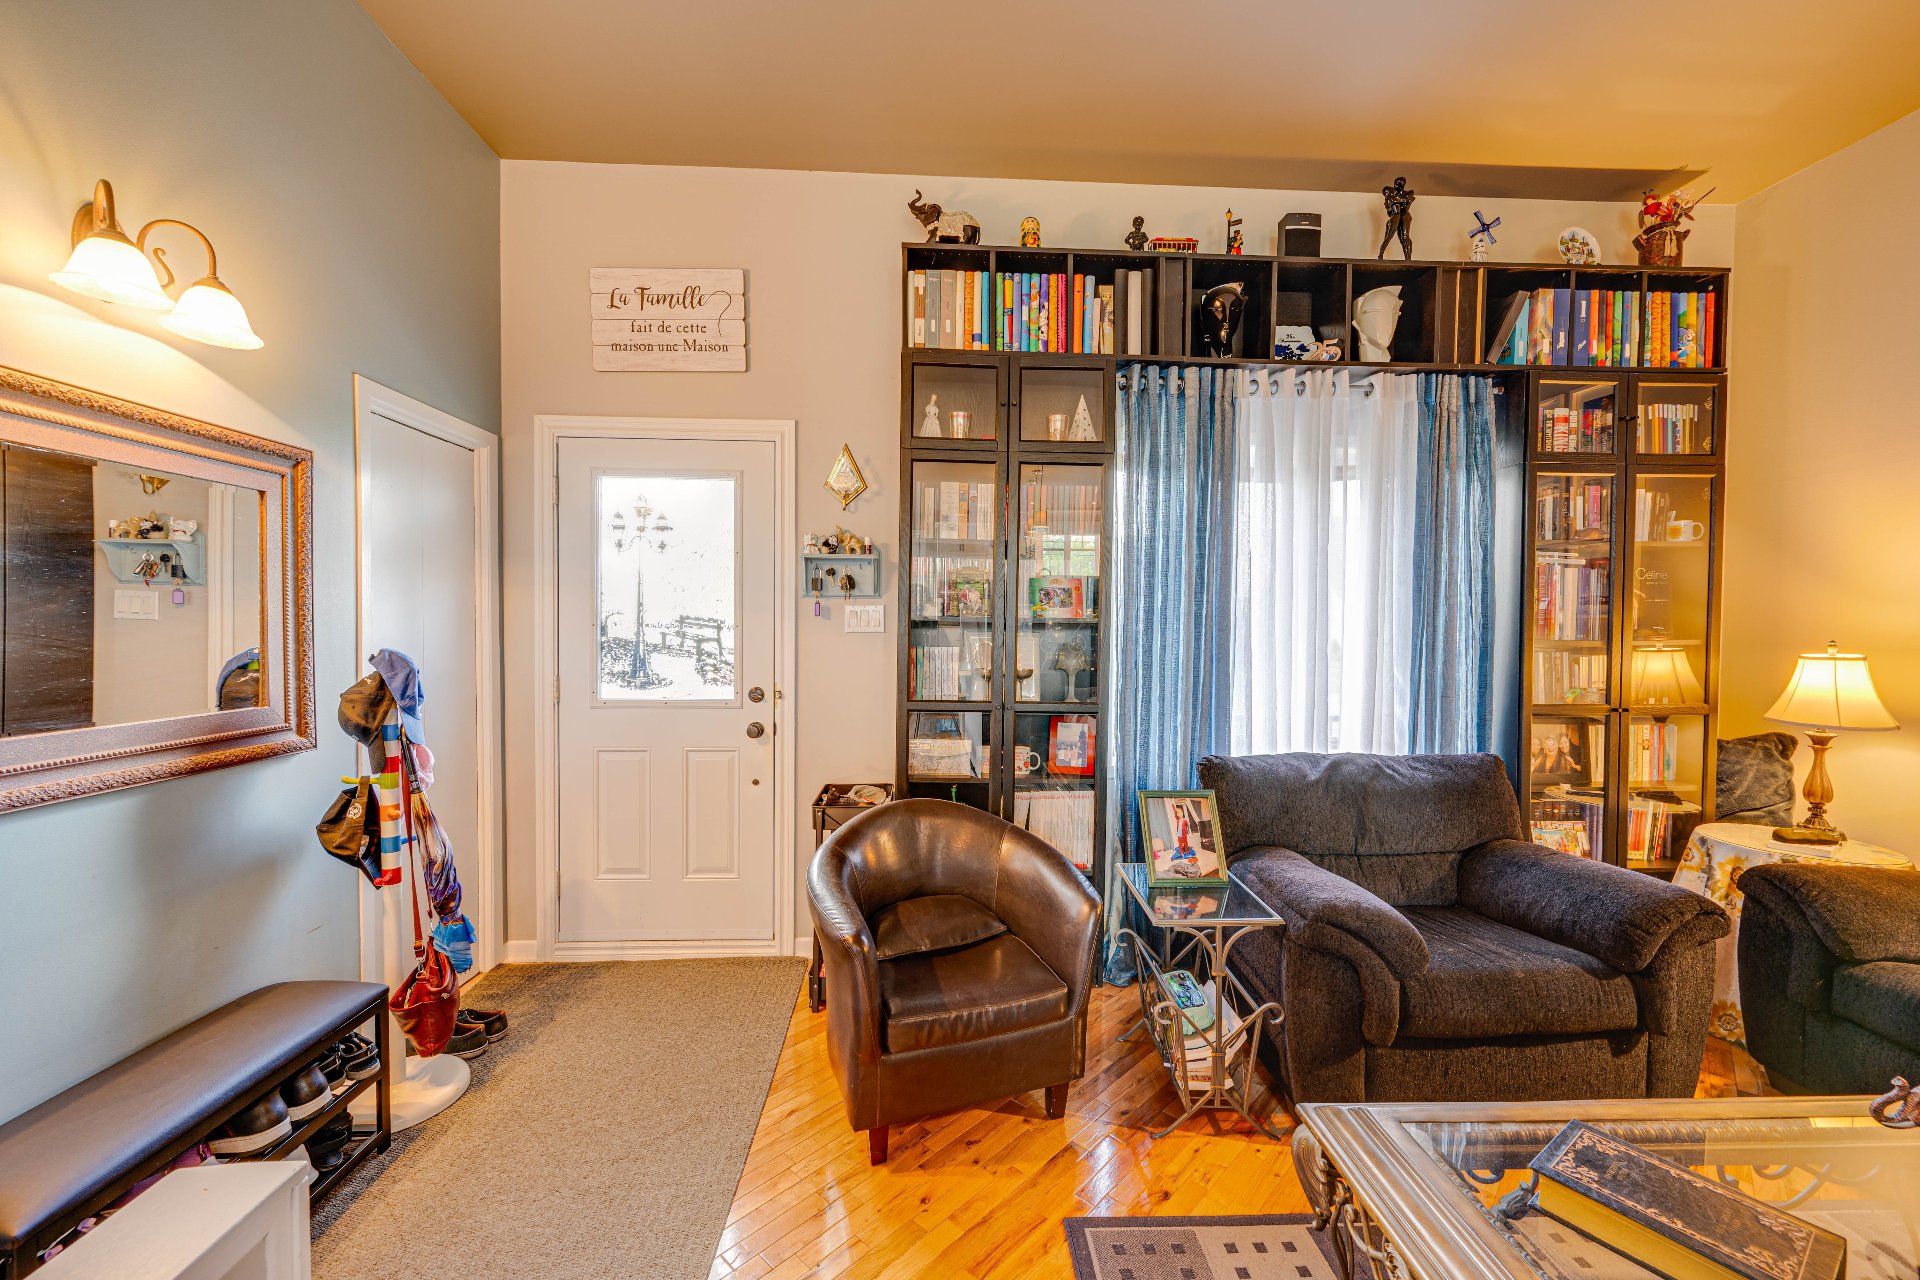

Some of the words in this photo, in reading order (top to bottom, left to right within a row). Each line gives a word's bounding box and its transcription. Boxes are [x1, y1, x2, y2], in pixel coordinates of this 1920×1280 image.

[606, 287, 630, 310] La
[633, 285, 707, 312] Famille
[630, 320, 653, 333] fait
[657, 320, 672, 333] de
[676, 321, 707, 334] cette
[611, 339, 654, 352] maison
[658, 344, 679, 352] une
[683, 339, 729, 352] Maison
[1635, 567, 1669, 580] Céline
